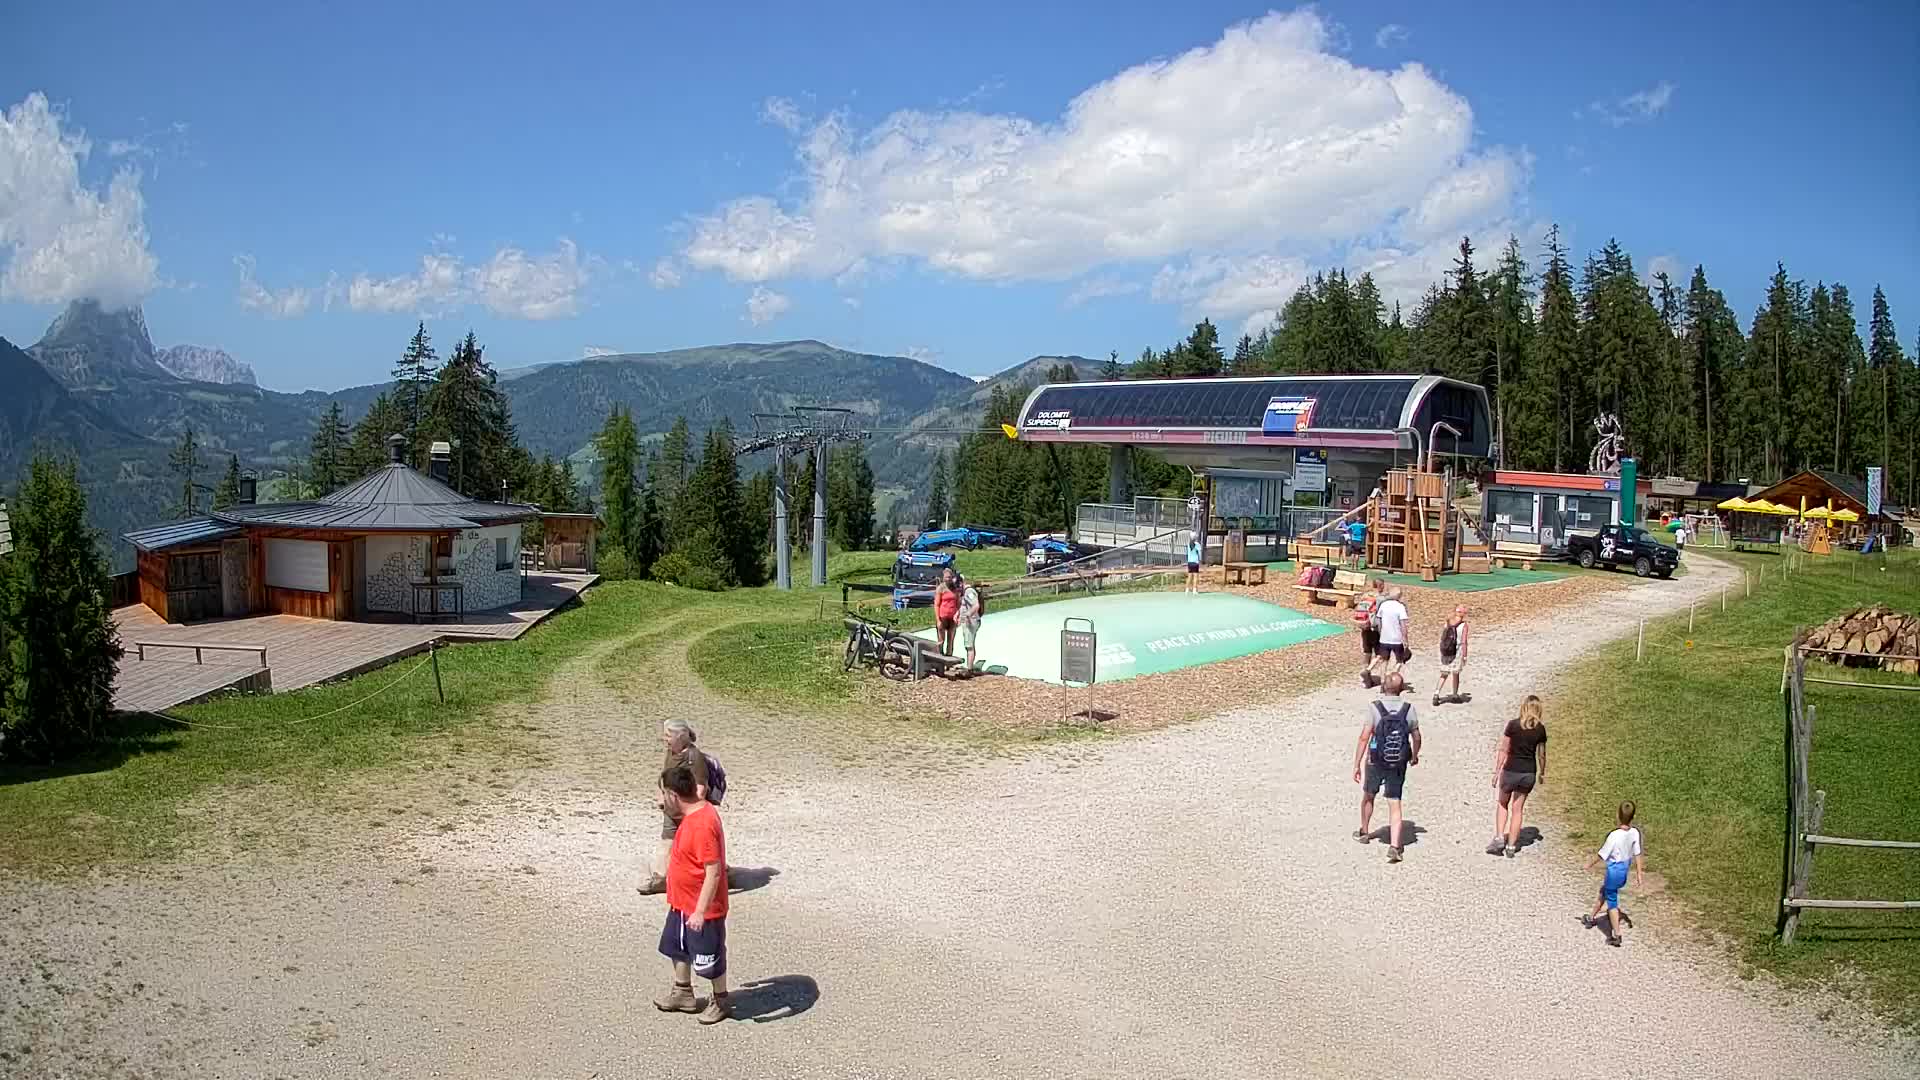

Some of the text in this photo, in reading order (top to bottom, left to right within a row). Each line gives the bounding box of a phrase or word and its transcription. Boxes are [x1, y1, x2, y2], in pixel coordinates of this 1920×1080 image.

[1026, 418, 1060, 426] SUPERSKI
[1145, 635, 1190, 653] PEACE
[1189, 632, 1208, 645] OF
[1206, 628, 1238, 642] MIND
[1235, 627, 1250, 638] IN
[1249, 623, 1271, 635] ALL
[695, 953, 716, 964] NIKE
